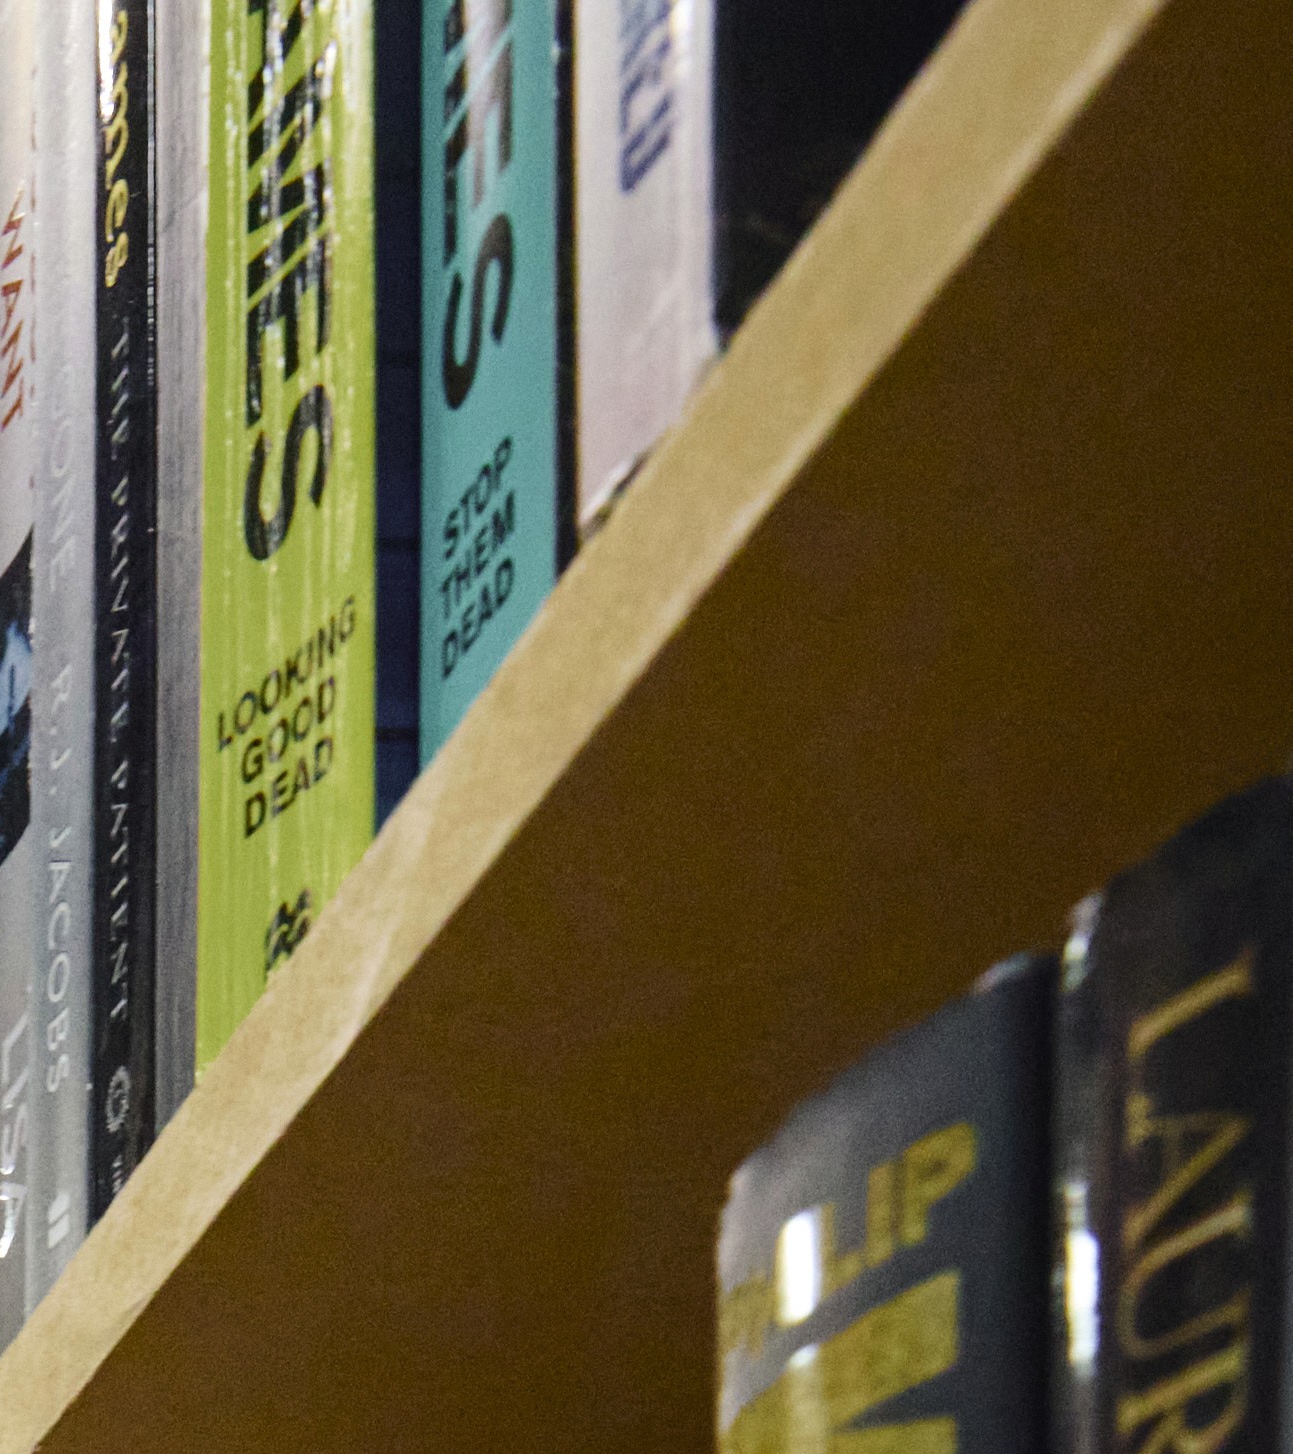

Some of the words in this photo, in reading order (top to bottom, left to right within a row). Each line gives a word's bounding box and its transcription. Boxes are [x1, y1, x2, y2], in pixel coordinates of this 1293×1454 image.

[1, 183, 27, 430] WANT
[442, 435, 512, 561] STOP
[442, 490, 515, 620] THEM
[217, 594, 358, 753] LOOKING
[441, 556, 515, 681] DEAD
[241, 675, 337, 786] GOOD
[243, 738, 334, 839] DEAD
[45, 826, 75, 1094] JACOBS
